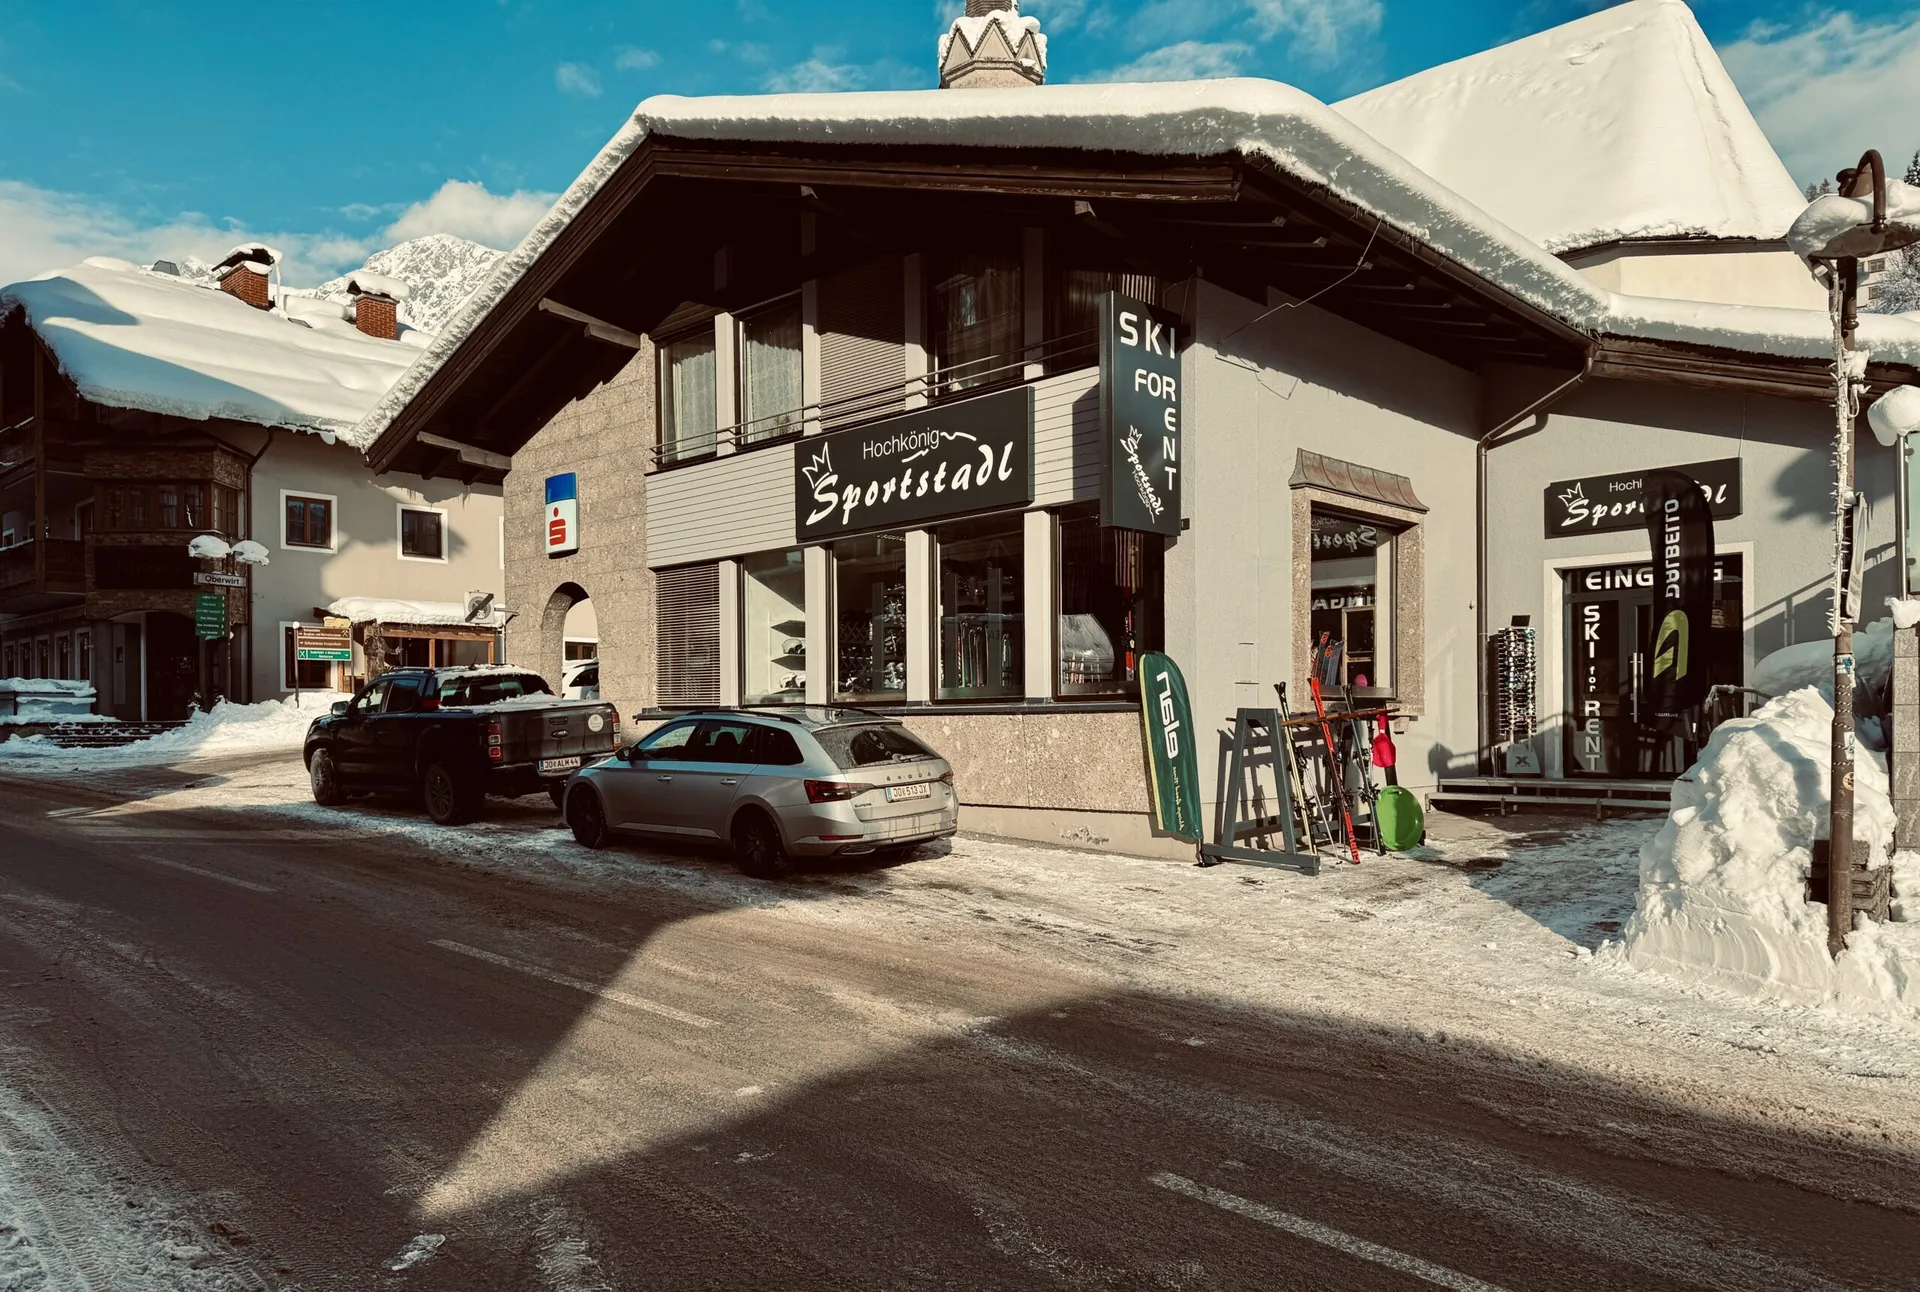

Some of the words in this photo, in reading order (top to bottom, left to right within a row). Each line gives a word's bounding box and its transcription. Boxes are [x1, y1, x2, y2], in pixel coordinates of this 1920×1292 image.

[1120, 311, 1175, 359] SKI
[1135, 368, 1176, 402] FOR
[863, 427, 940, 459] Hochkönig
[805, 441, 1014, 525] Sportstadl
[1120, 437, 1164, 515] Sportstadl
[205, 574, 240, 585] Oberwirt
[1584, 605, 1600, 658] SKI
[1588, 665, 1597, 692] for
[1584, 700, 1600, 771] RENT
[906, 785, 918, 795] 513
